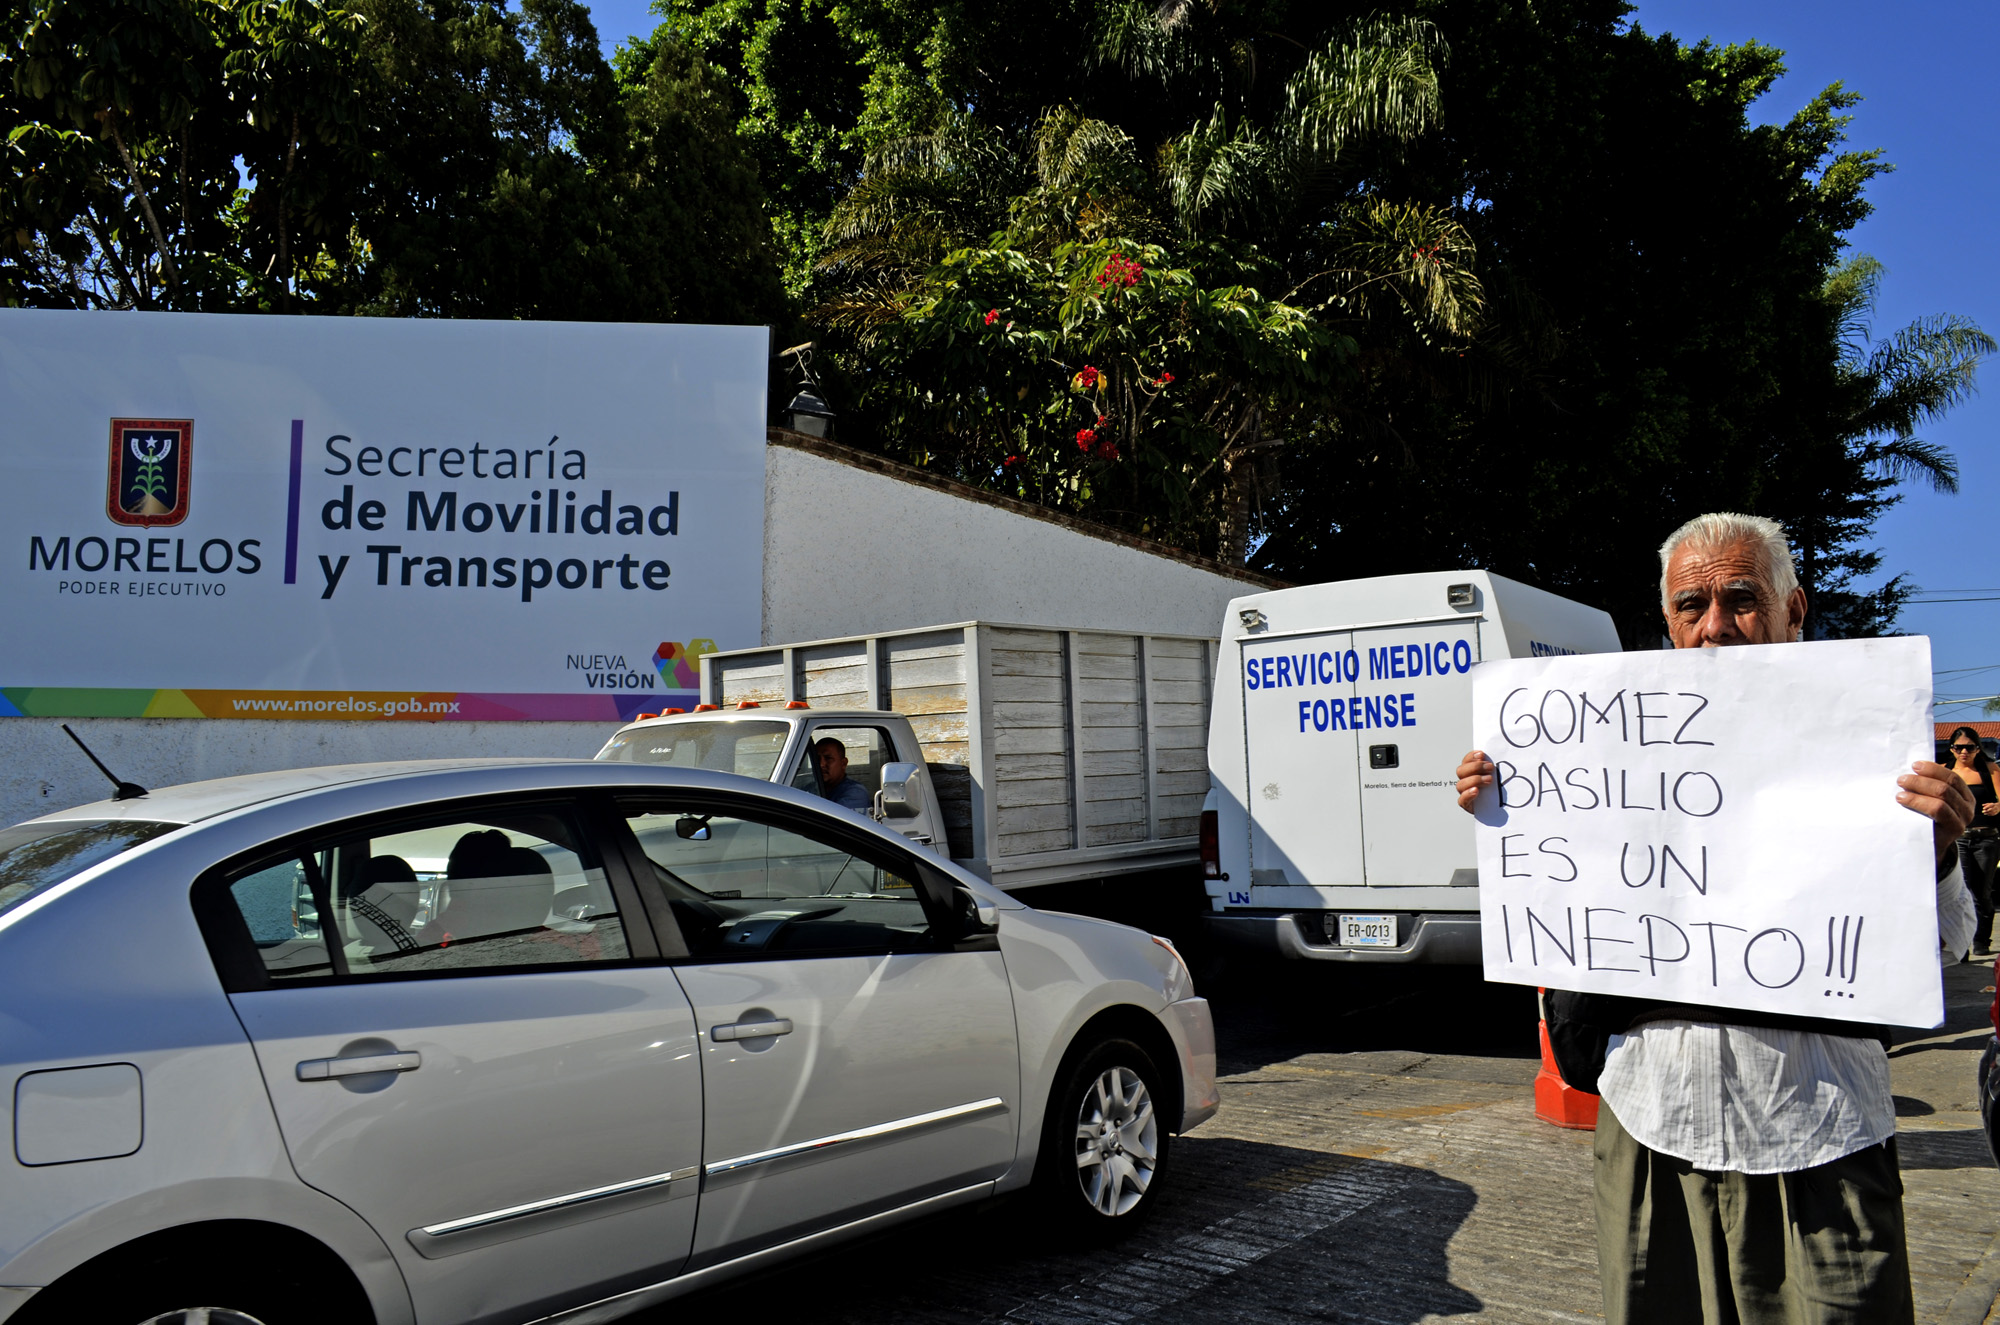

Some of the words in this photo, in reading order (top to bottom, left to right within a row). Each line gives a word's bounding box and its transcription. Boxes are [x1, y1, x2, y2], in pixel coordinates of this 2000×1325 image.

[324, 435, 586, 480] Secretaría
[321, 484, 386, 531] de
[406, 489, 679, 536] Movilidad
[29, 536, 262, 574] MORELOS
[318, 555, 350, 600] y
[366, 545, 671, 602] Transporte
[59, 581, 120, 595] PODER
[128, 582, 226, 597] EJECUTIVO
[567, 654, 627, 670] NUEVA
[586, 670, 655, 689] VISIÓN
[1247, 649, 1360, 690] SERVICIO
[1368, 639, 1472, 681] MEDICO
[232, 697, 460, 716] www.morelos.gob.mx
[1299, 693, 1416, 733] FORENSE
[1499, 687, 1714, 748] GOMEZ
[1496, 760, 1722, 817] BASILIO
[1501, 834, 1578, 882] ES
[1621, 843, 1707, 896] UN
[1348, 923, 1390, 938] ER-0213
